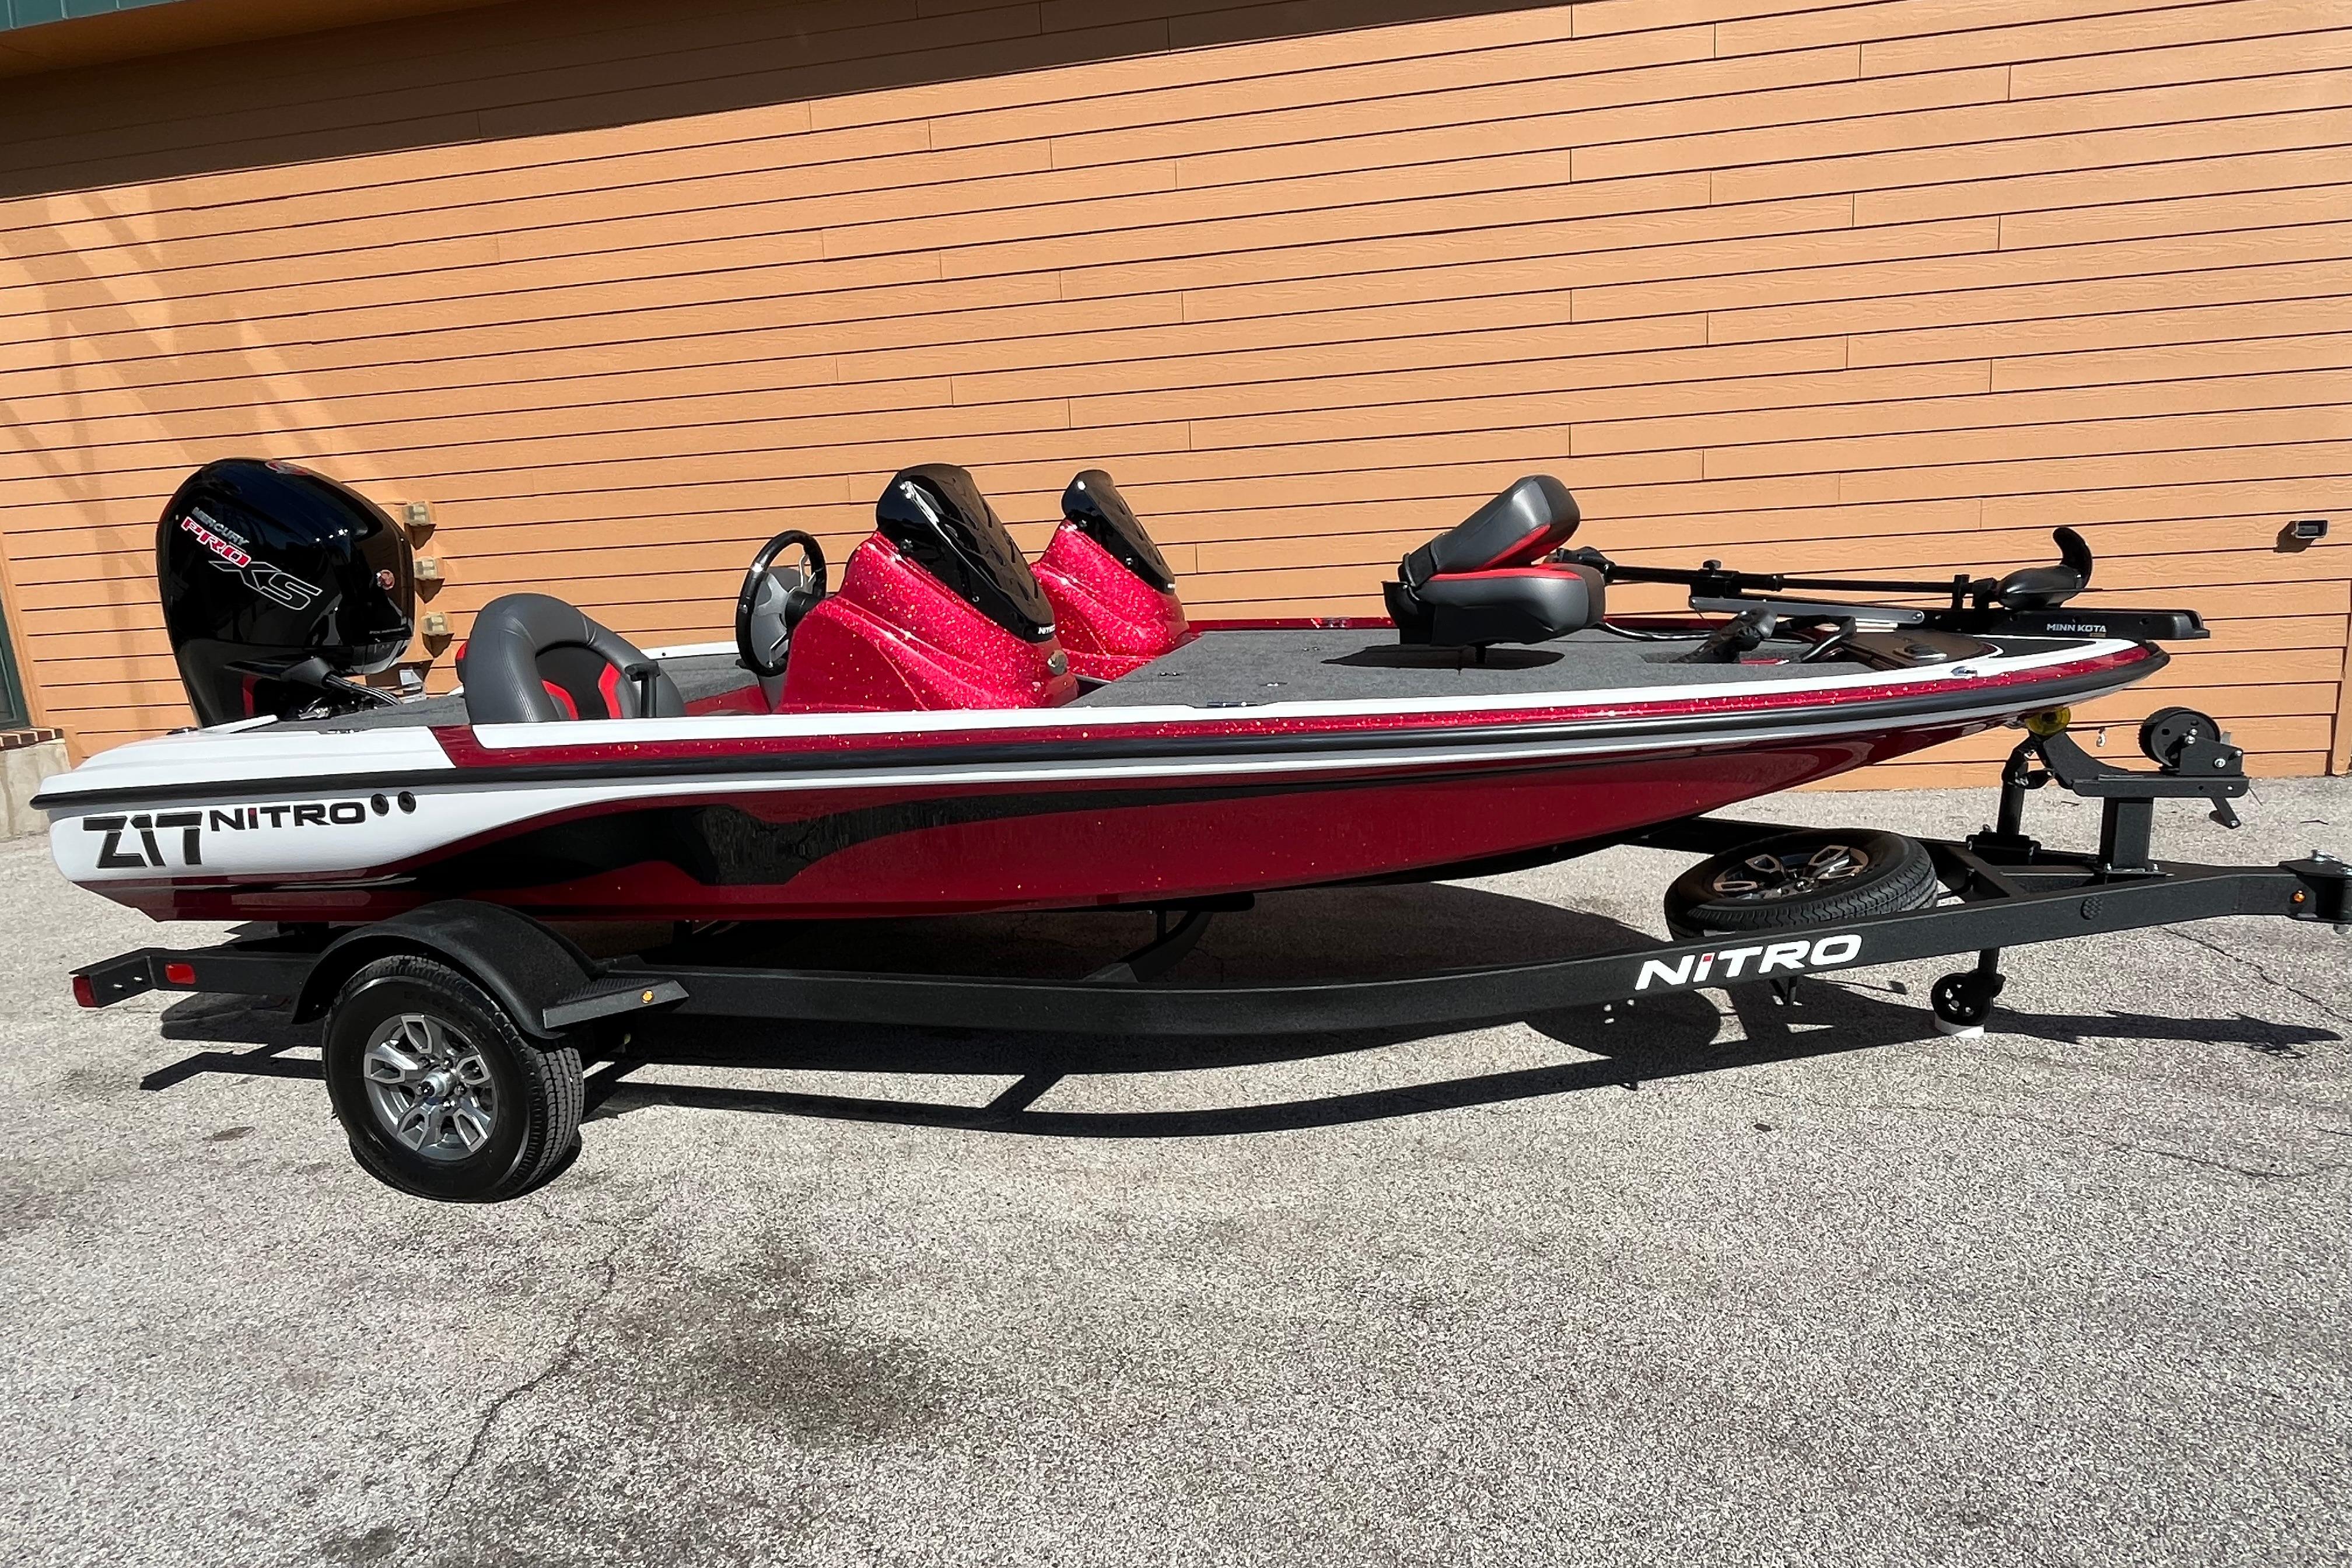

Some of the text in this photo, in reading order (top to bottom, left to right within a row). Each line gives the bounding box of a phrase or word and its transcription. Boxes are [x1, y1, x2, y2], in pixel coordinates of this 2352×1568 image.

[192, 506, 250, 546] MERCURY
[181, 516, 323, 610] PRO XS
[2077, 624, 2106, 632] KOTA
[82, 801, 366, 869] Z17 NITRO
